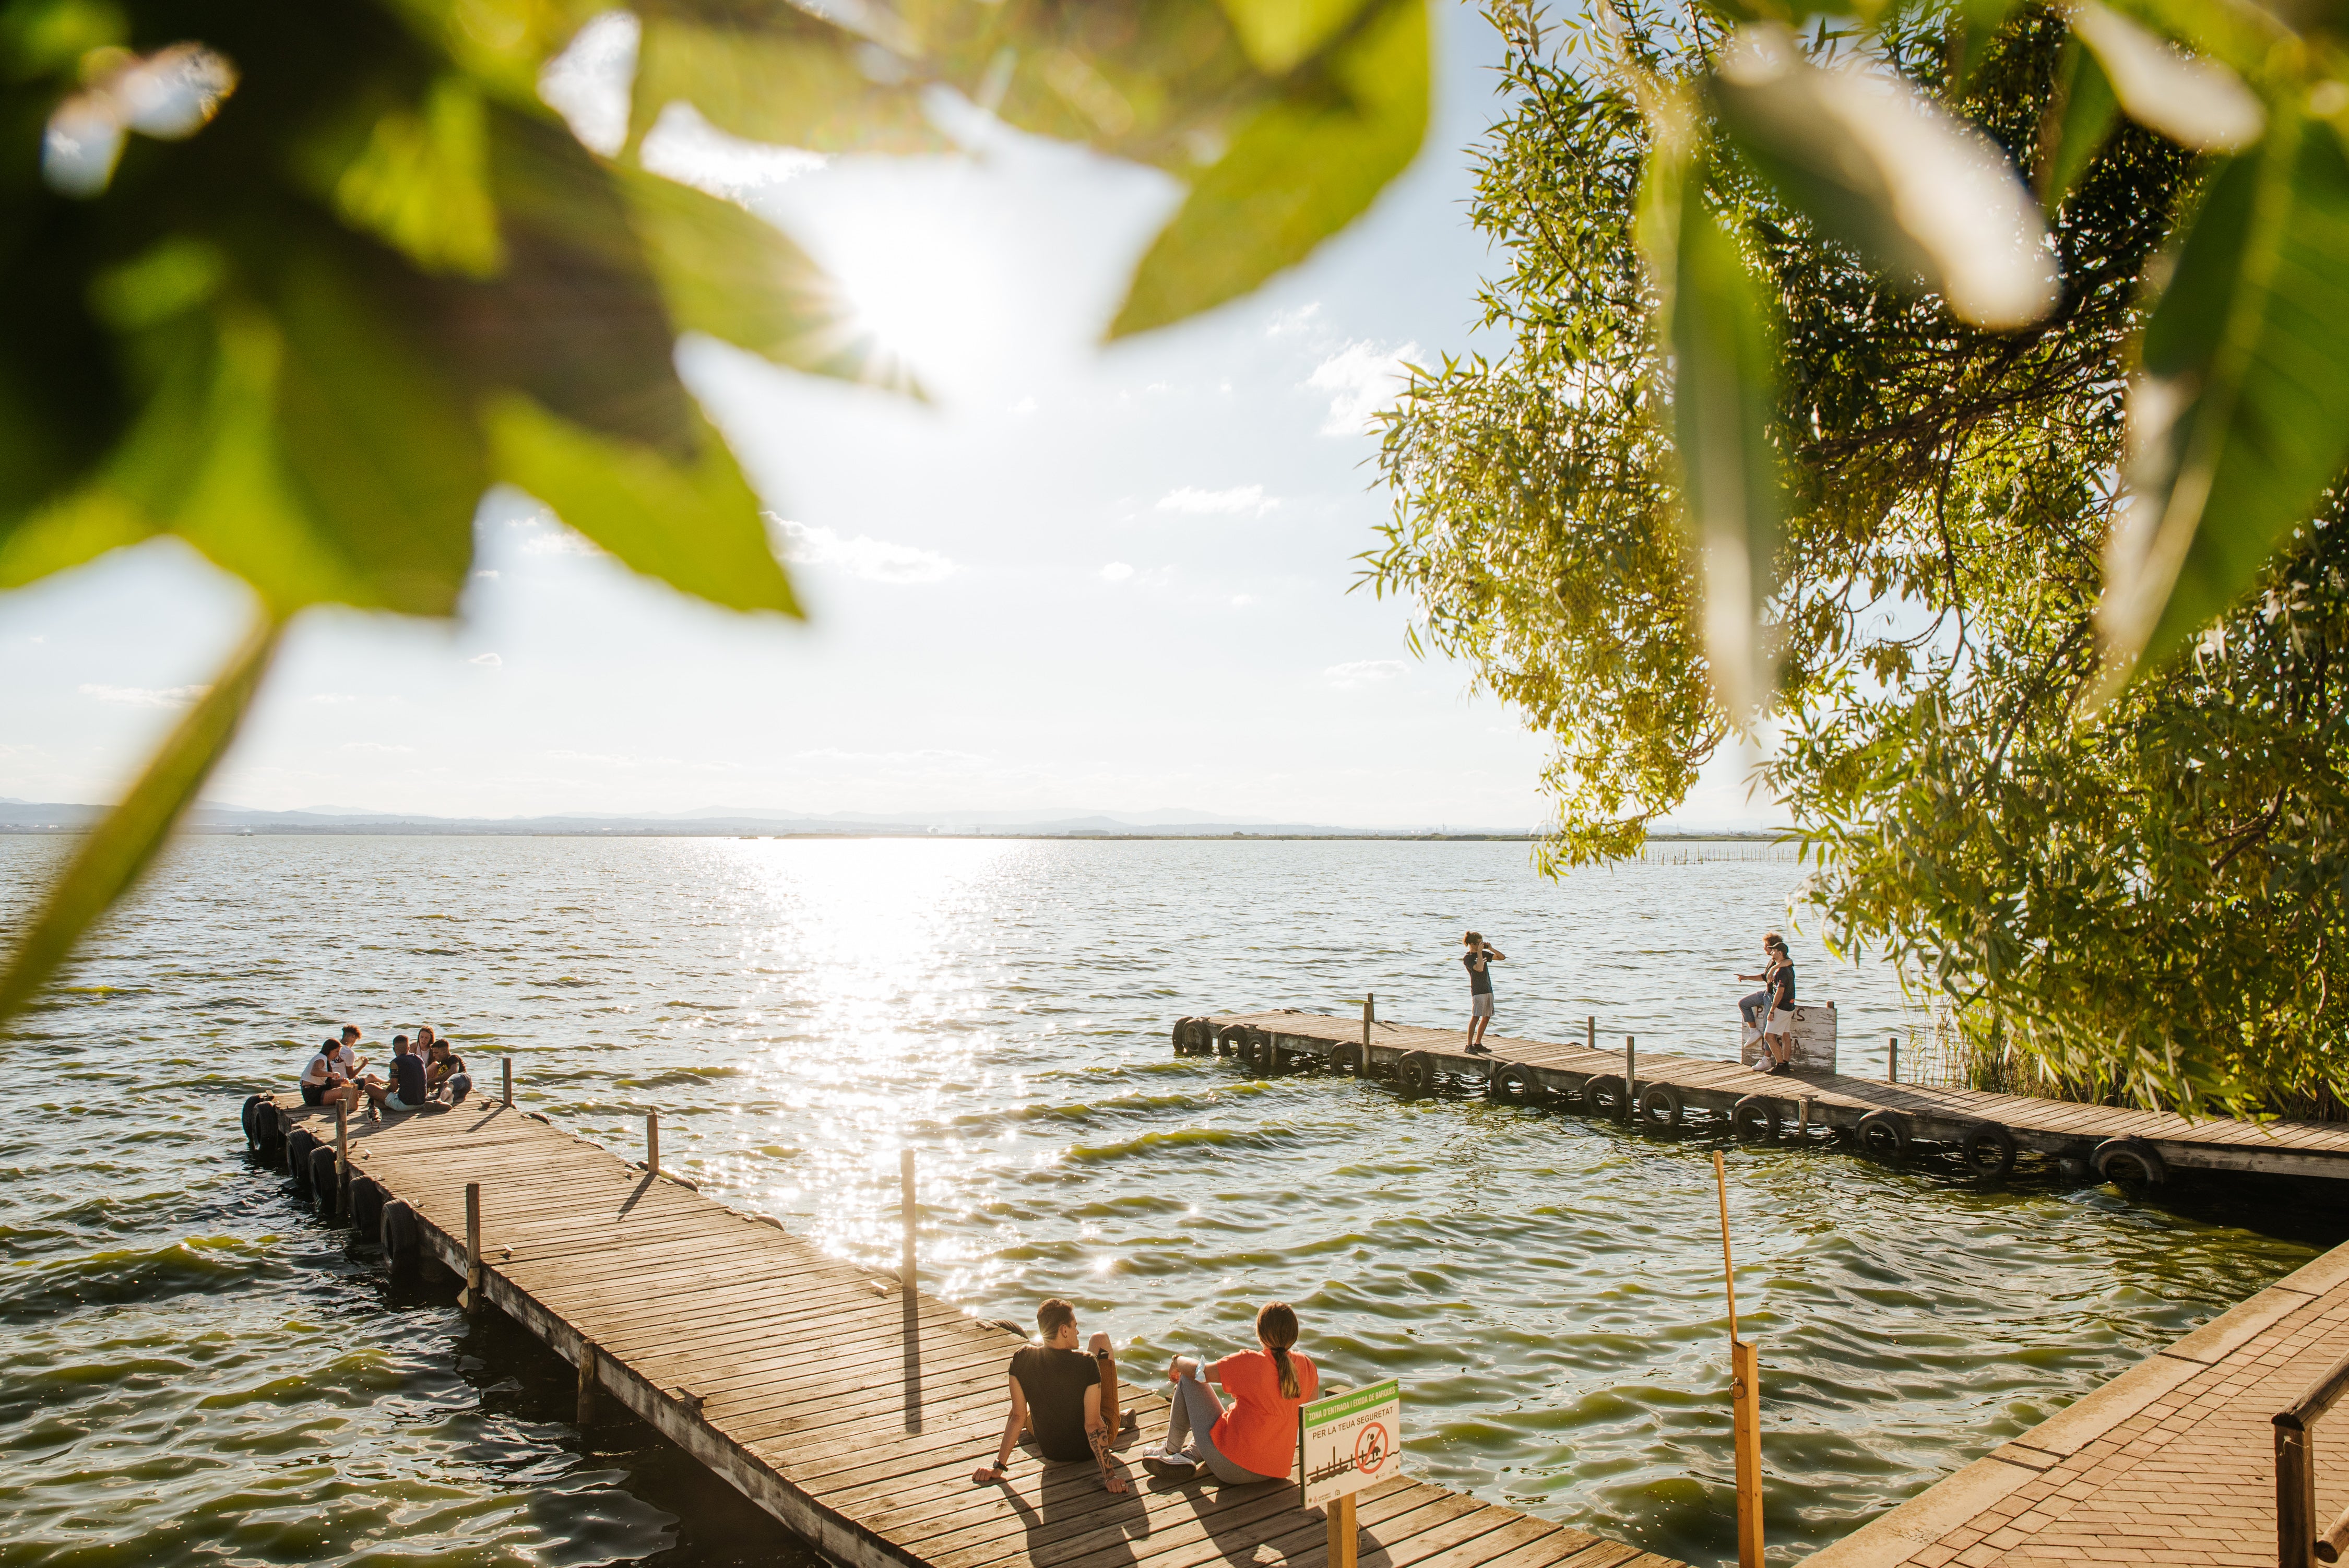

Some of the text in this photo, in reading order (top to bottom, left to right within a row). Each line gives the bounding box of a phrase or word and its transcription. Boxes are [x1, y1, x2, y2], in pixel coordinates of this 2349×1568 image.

[1309, 1411, 1322, 1421] ZONA
[1323, 1401, 1349, 1416] D'ENTRADA
[1353, 1396, 1368, 1407] EIXIDA
[1369, 1393, 1374, 1401] DE
[1375, 1386, 1395, 1400] BARQUES
[1313, 1429, 1326, 1440] PER
[1328, 1426, 1336, 1435] LA
[1338, 1420, 1355, 1431] TEUA
[1357, 1406, 1393, 1425] SEGURETAT
